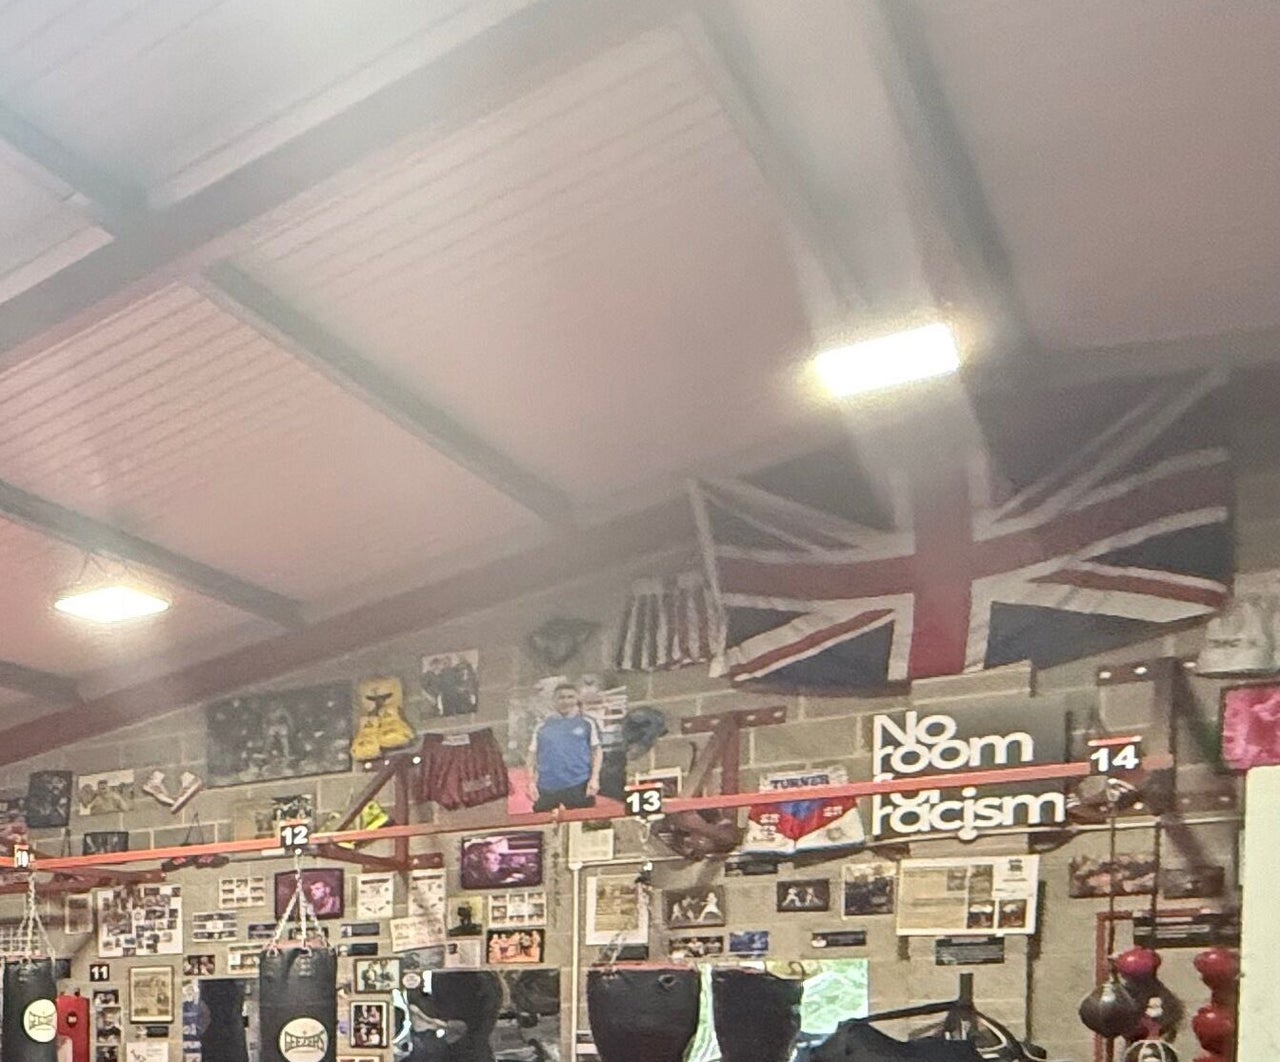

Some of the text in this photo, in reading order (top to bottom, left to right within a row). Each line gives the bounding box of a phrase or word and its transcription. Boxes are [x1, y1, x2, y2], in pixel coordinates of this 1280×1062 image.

[872, 711, 957, 746] No
[872, 732, 1034, 776] room
[1090, 745, 1139, 772] 14
[626, 790, 662, 813] 13
[872, 787, 1066, 836] racism
[281, 826, 308, 845] 12
[91, 965, 109, 980] 11
[284, 1030, 326, 1053] GEEZERS
